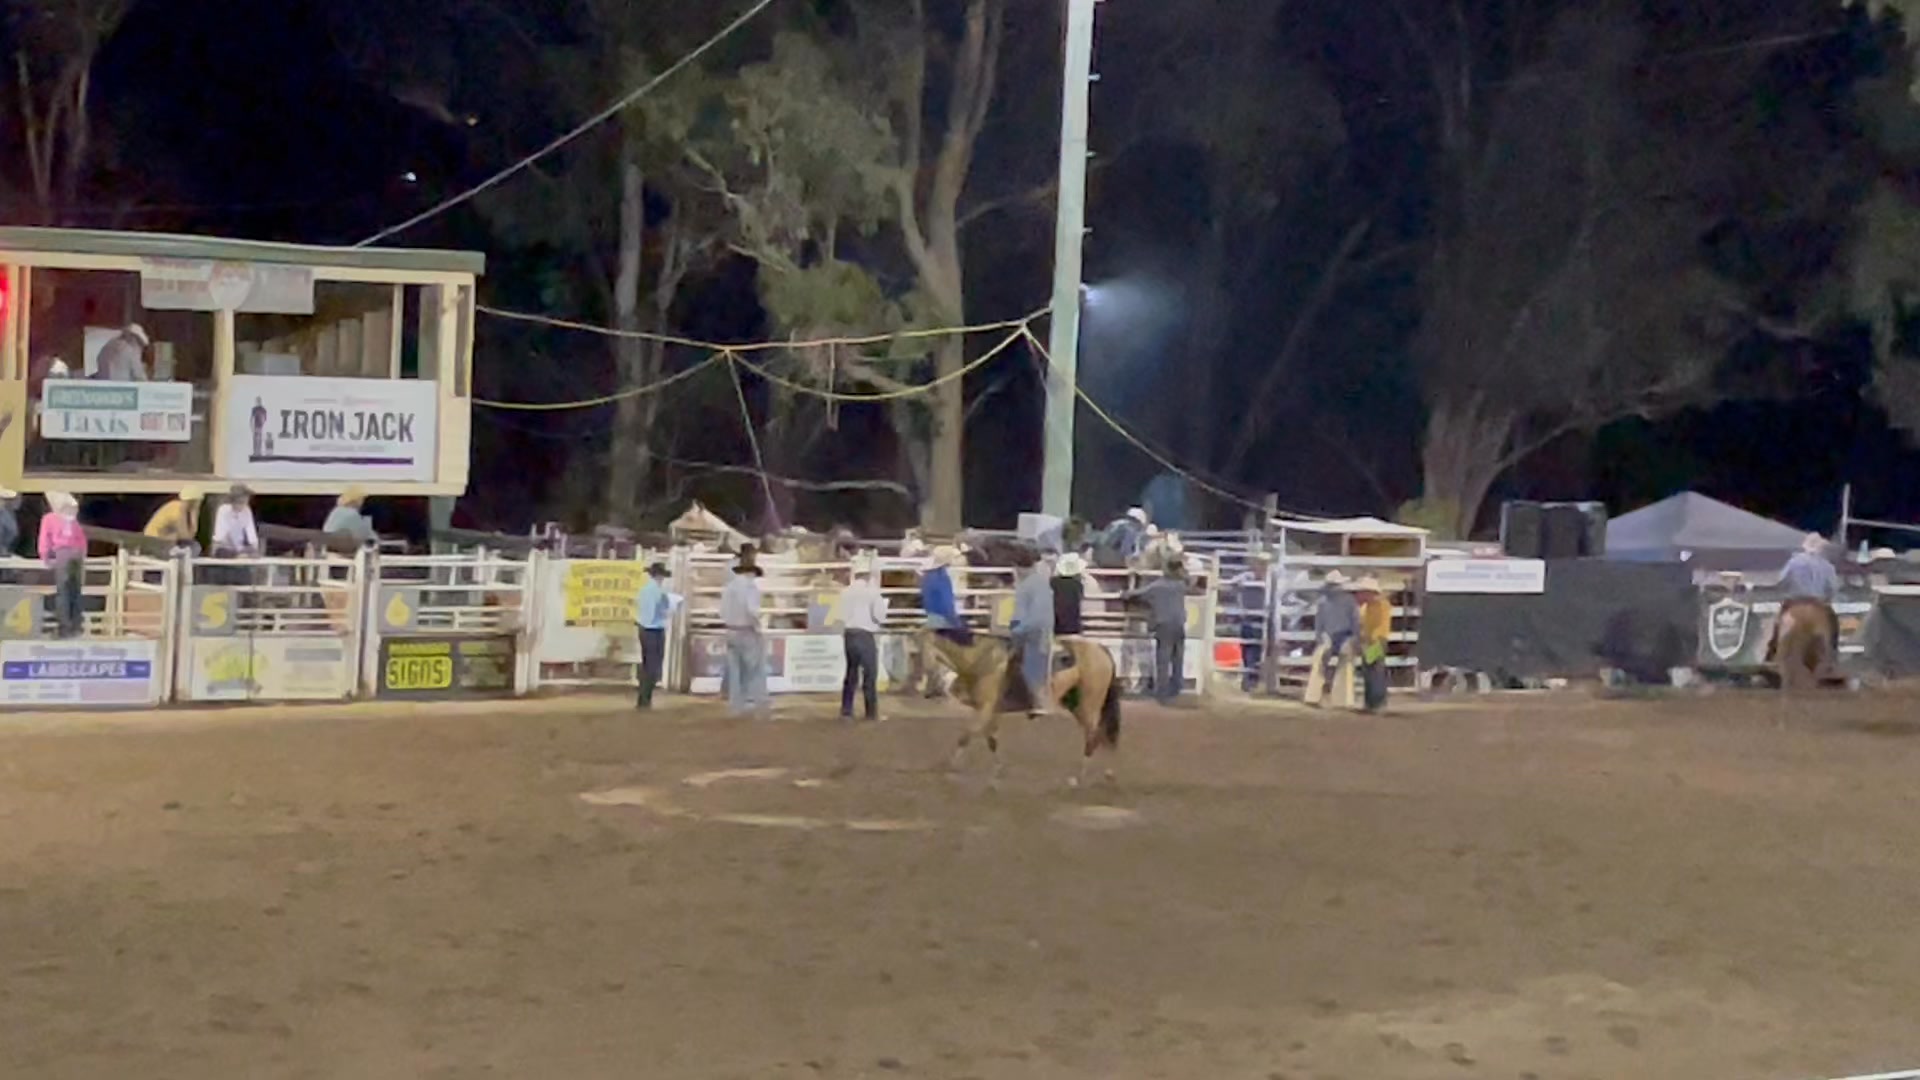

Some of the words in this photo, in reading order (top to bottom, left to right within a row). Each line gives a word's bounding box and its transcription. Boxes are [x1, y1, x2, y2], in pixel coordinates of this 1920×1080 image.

[57, 411, 129, 432] Taxis
[278, 409, 344, 440] IRON
[348, 412, 415, 443] JACK
[4, 599, 33, 635] 4
[195, 591, 229, 629] 5
[385, 591, 410, 627] 6
[28, 661, 127, 679] LANDSCAPES
[387, 658, 444, 687] SIGNS
